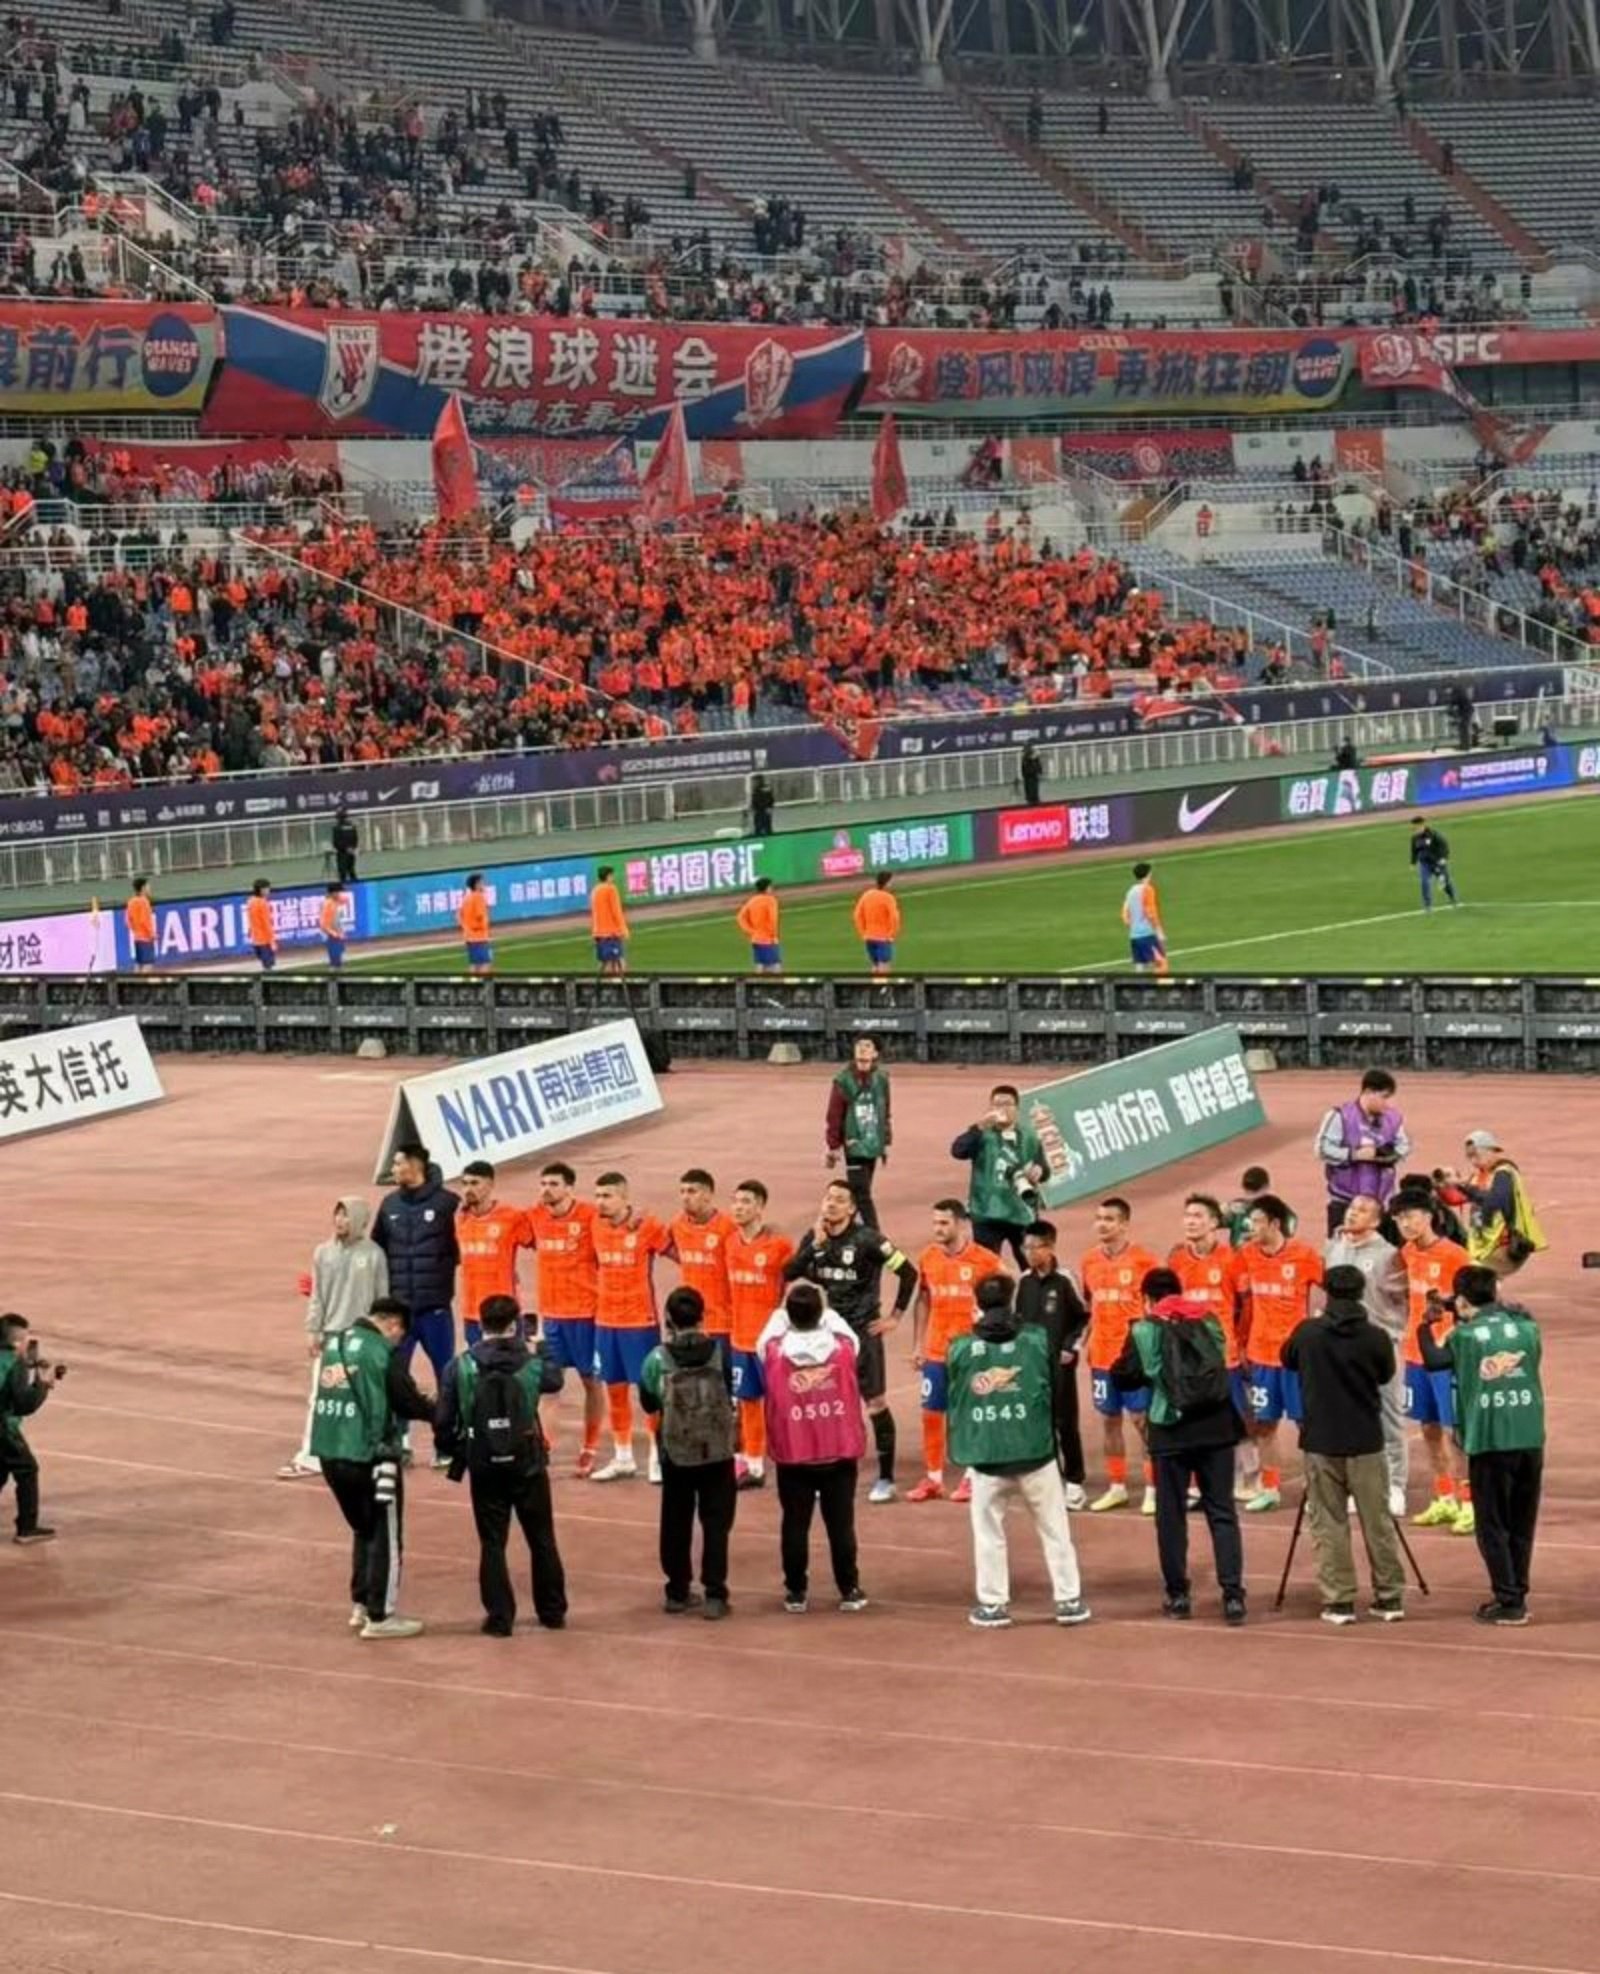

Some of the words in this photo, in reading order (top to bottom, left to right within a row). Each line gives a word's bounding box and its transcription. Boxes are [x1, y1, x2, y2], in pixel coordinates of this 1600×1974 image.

[145, 340, 197, 357] ORANGE
[417, 322, 719, 398] 橙浪球迷会
[467, 399, 646, 433] 荣耀东看台
[1005, 819, 1062, 843] Lenovo
[1069, 804, 1110, 841] 联想
[869, 824, 948, 866] 青岛啤酒
[651, 844, 765, 896] 锅圈食汇
[0, 1040, 129, 1118] 英大信托
[532, 1041, 639, 1111] 南瑞集团
[436, 1069, 545, 1157] NARI
[317, 1399, 355, 1418] 0516
[791, 1400, 845, 1421] 0502
[972, 1402, 1027, 1422] 0543
[1251, 1386, 1269, 1407] 25
[1480, 1389, 1532, 1408] 0539
